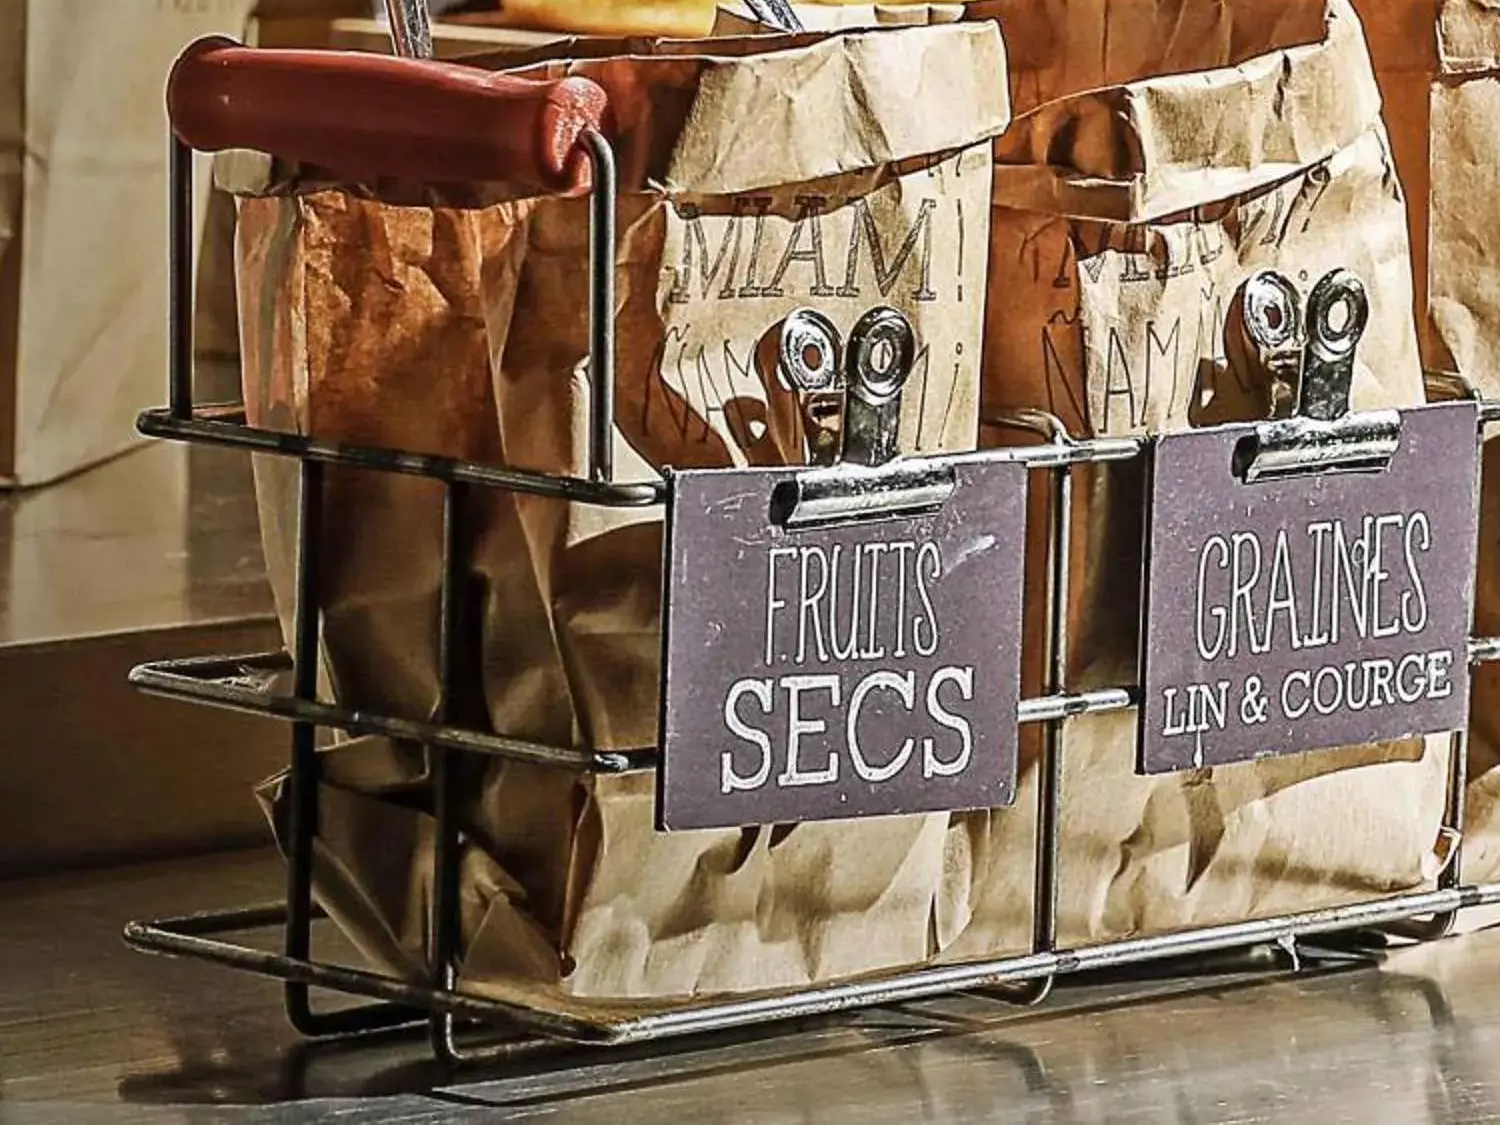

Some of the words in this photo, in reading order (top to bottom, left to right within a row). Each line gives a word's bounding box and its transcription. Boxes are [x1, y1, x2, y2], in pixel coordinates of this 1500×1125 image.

[765, 539, 942, 666] FRUITS
[1196, 510, 1431, 661] GRAINES
[720, 665, 975, 794] SECS
[1162, 679, 1231, 737] LIN
[1240, 675, 1269, 725] &
[1281, 650, 1454, 720] COURGE
